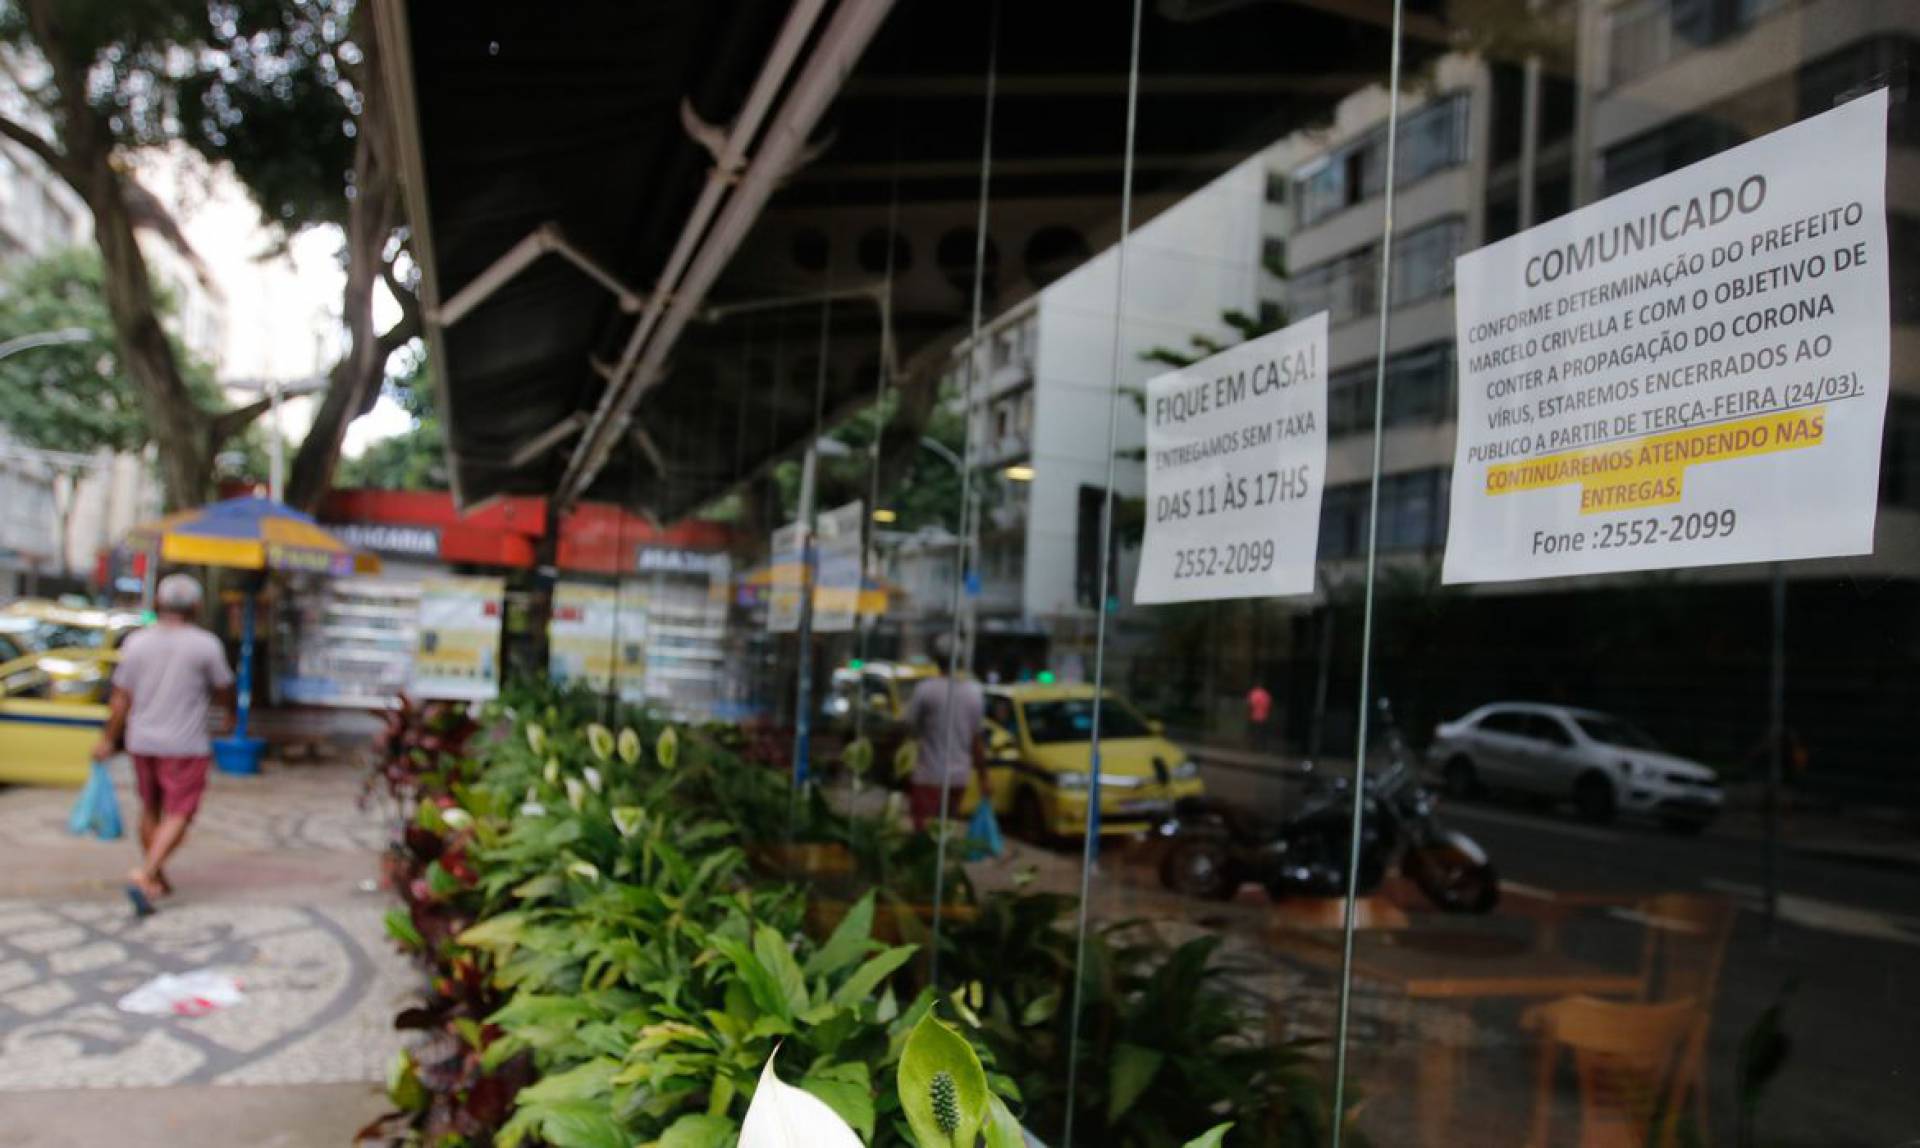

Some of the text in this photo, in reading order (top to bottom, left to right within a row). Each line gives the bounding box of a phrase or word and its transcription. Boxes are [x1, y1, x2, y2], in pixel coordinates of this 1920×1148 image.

[1469, 201, 1863, 344] CONFORME DETERMINAÇÃO DO PREFEITO
[1525, 174, 1767, 288] COMUNICADO
[1469, 241, 1867, 374] MARCELO CRIVELLA E COM O OBJETIVO DE
[1487, 293, 1834, 400] CONTER A PROPAGAÇÃO DO CORONA
[1156, 343, 1316, 427] FIQUE EM CASA!
[1467, 371, 1864, 464] PUBLICO A PARTIR DE TERÇA-FEIRA (24/03).
[1487, 333, 1832, 430] VÍRUS, ESTAREMOS ENCERRADOS AO
[1156, 409, 1316, 471] ENTREGAMOS SEM TAXA
[1486, 415, 1824, 491] CONTINUAREMOS ATENDENDO NAS
[1157, 464, 1309, 523] DAS 11 ÀS 17HS
[1581, 476, 1681, 509] ENTREGAS.
[1174, 538, 1275, 580] 2552-2099
[1532, 530, 1585, 556] Fone
